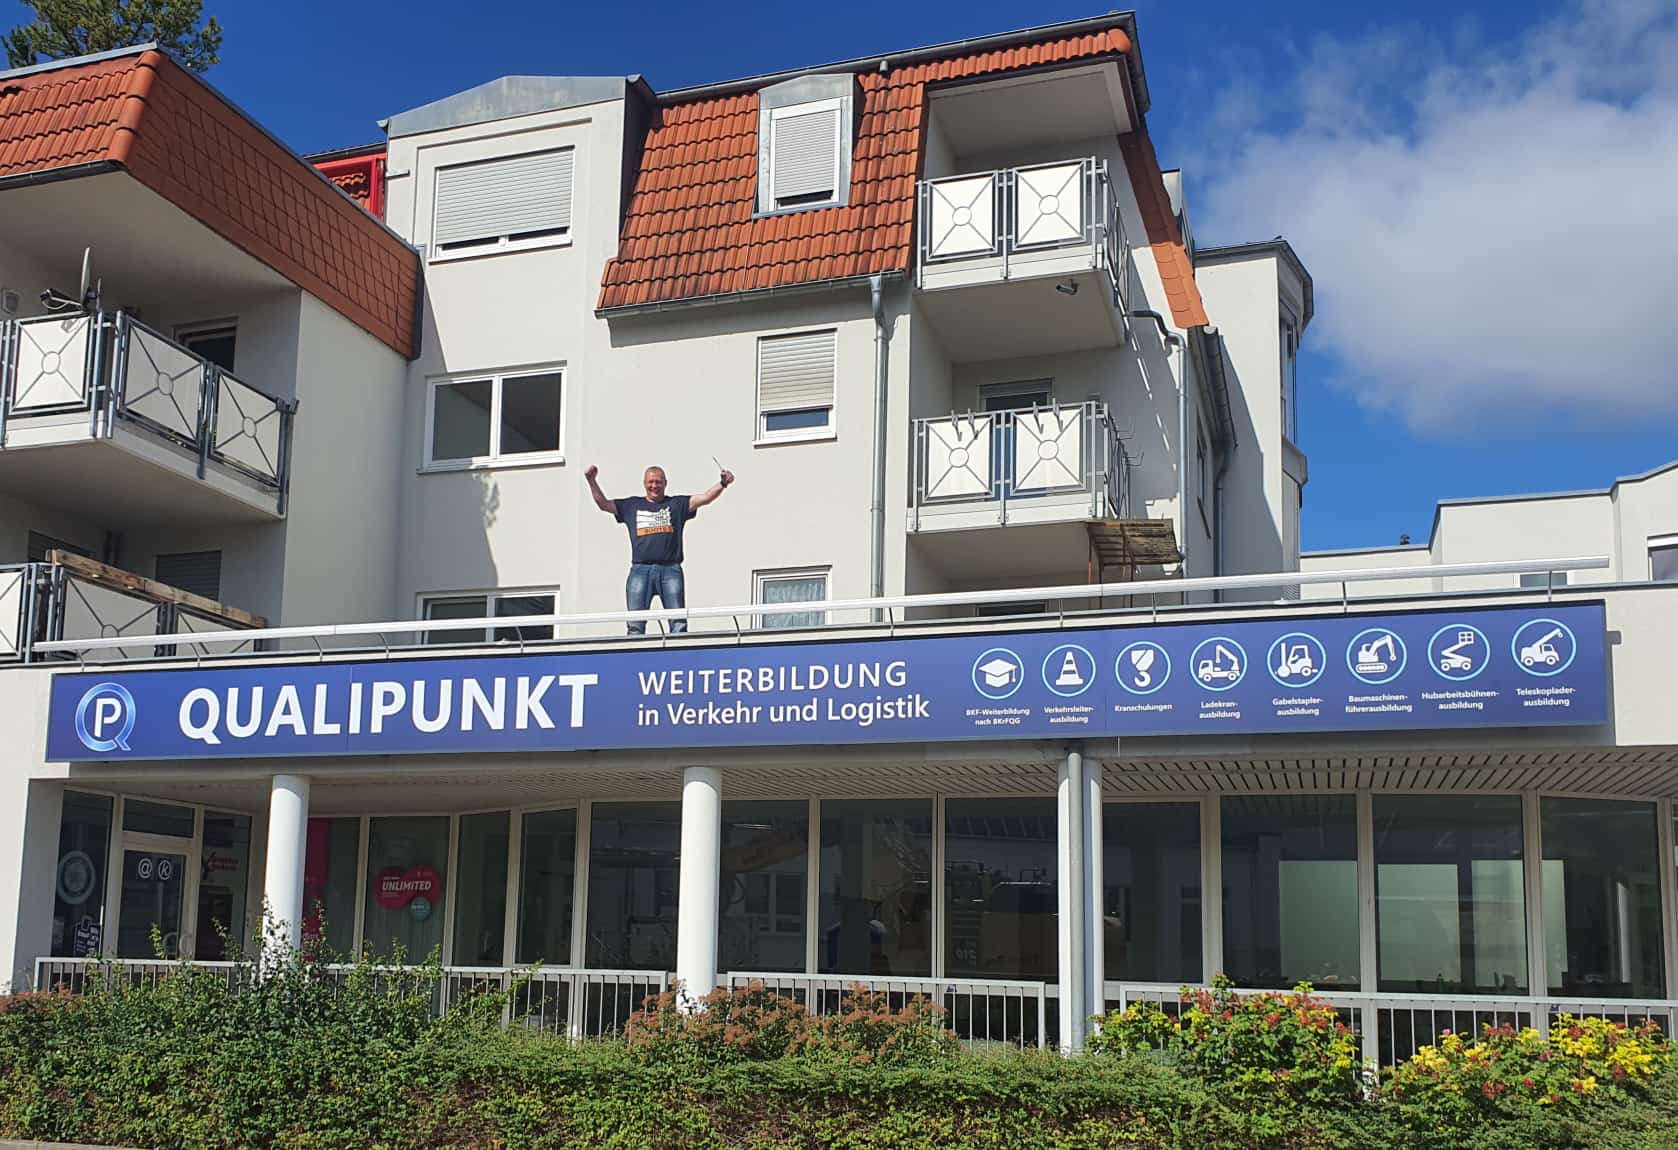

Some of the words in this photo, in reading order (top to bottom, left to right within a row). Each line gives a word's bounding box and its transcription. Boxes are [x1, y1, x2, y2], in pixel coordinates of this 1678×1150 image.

[638, 661, 907, 695] WEITERBILDUNG
[1421, 688, 1500, 700] Hubarbeitsbühnen-
[1515, 685, 1576, 697] Teleskoplader-
[1272, 696, 1323, 706] Gabelstapler-
[1348, 693, 1408, 703] Baumaschinen-
[1523, 697, 1570, 707] ausbildung
[178, 673, 598, 745] QUALIPUNKT
[1114, 703, 1173, 713] Kranschulungen
[1200, 700, 1239, 709] Ladekran-
[1345, 703, 1413, 713] führerausbildung
[1438, 700, 1484, 710] ausbildung
[637, 703, 659, 726] in
[667, 701, 762, 725] Verkehr
[769, 697, 818, 722] und
[827, 693, 930, 727] Logistik
[1199, 710, 1241, 720] ausbildung
[1277, 707, 1320, 717] ausbildung
[975, 717, 992, 726] nach
[1049, 715, 1089, 724] ausbildung
[381, 880, 432, 891] UNLIMITED
